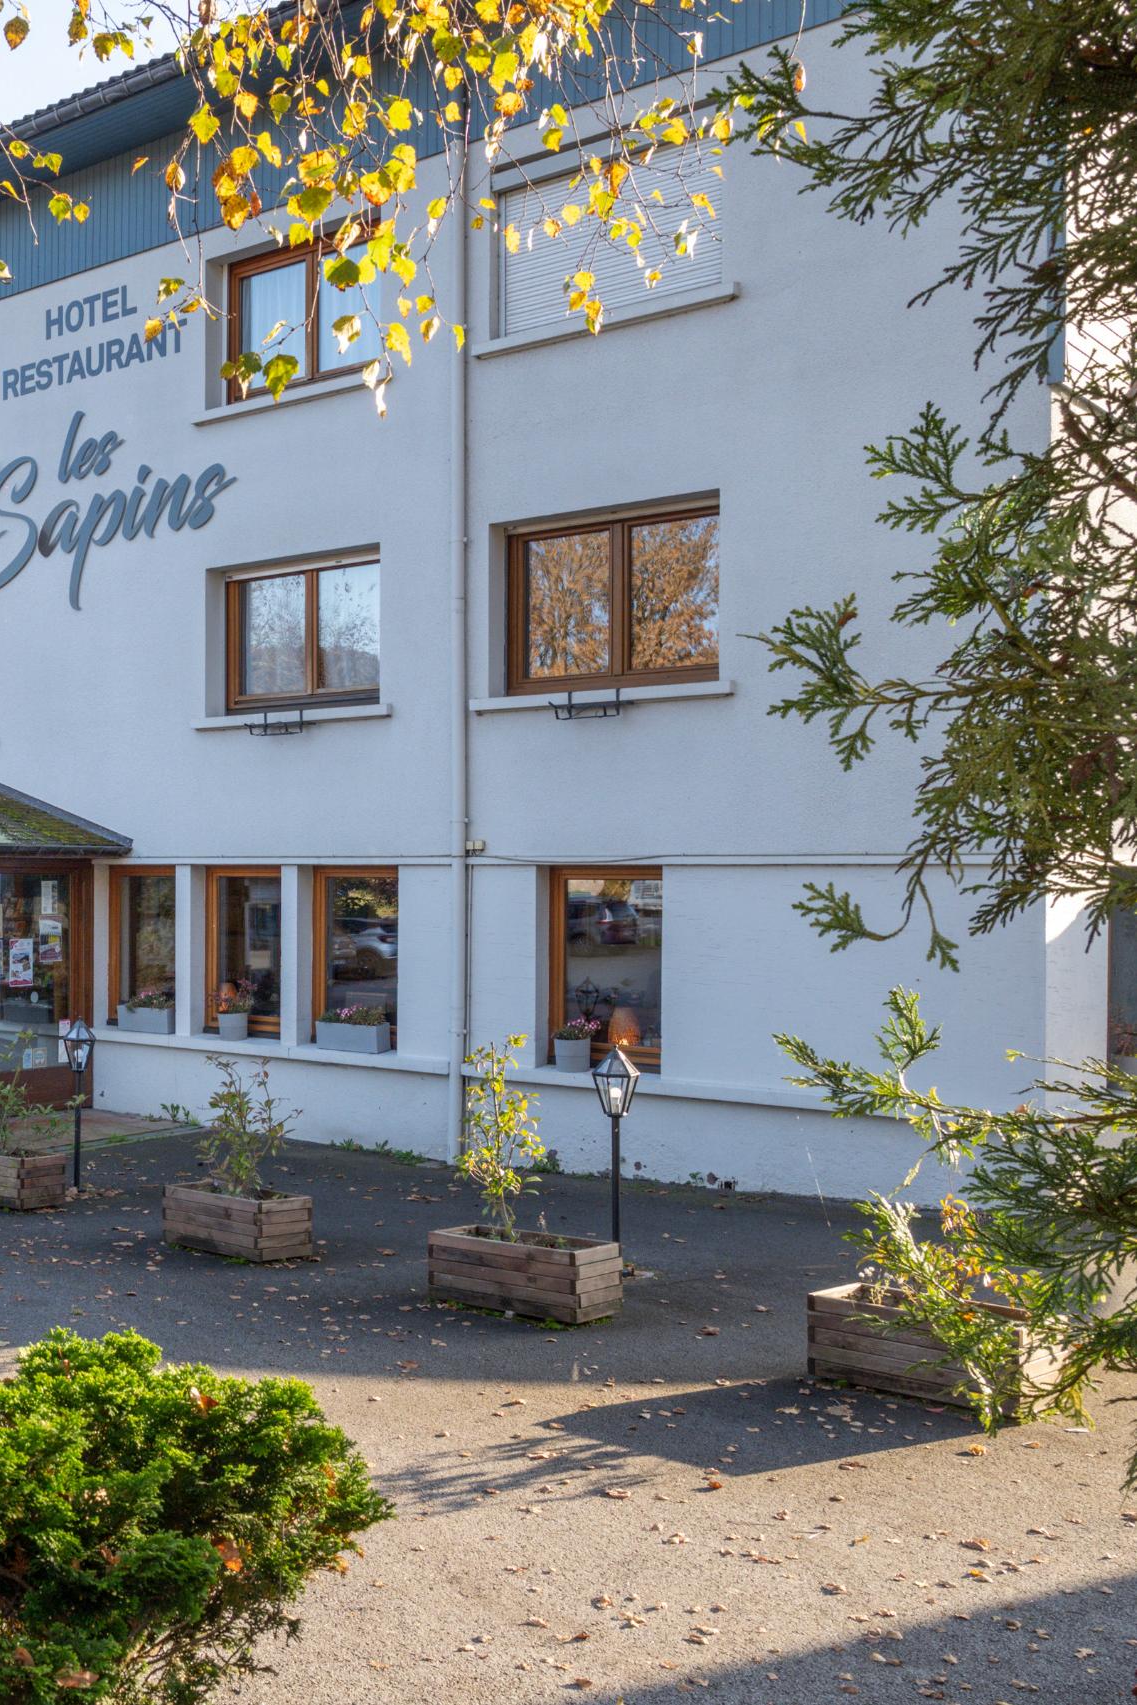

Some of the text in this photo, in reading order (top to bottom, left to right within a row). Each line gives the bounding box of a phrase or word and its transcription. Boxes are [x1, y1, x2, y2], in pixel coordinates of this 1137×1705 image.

[46, 285, 137, 340] HOTEL
[2, 318, 188, 400] RESTAURANT
[58, 411, 126, 484] les
